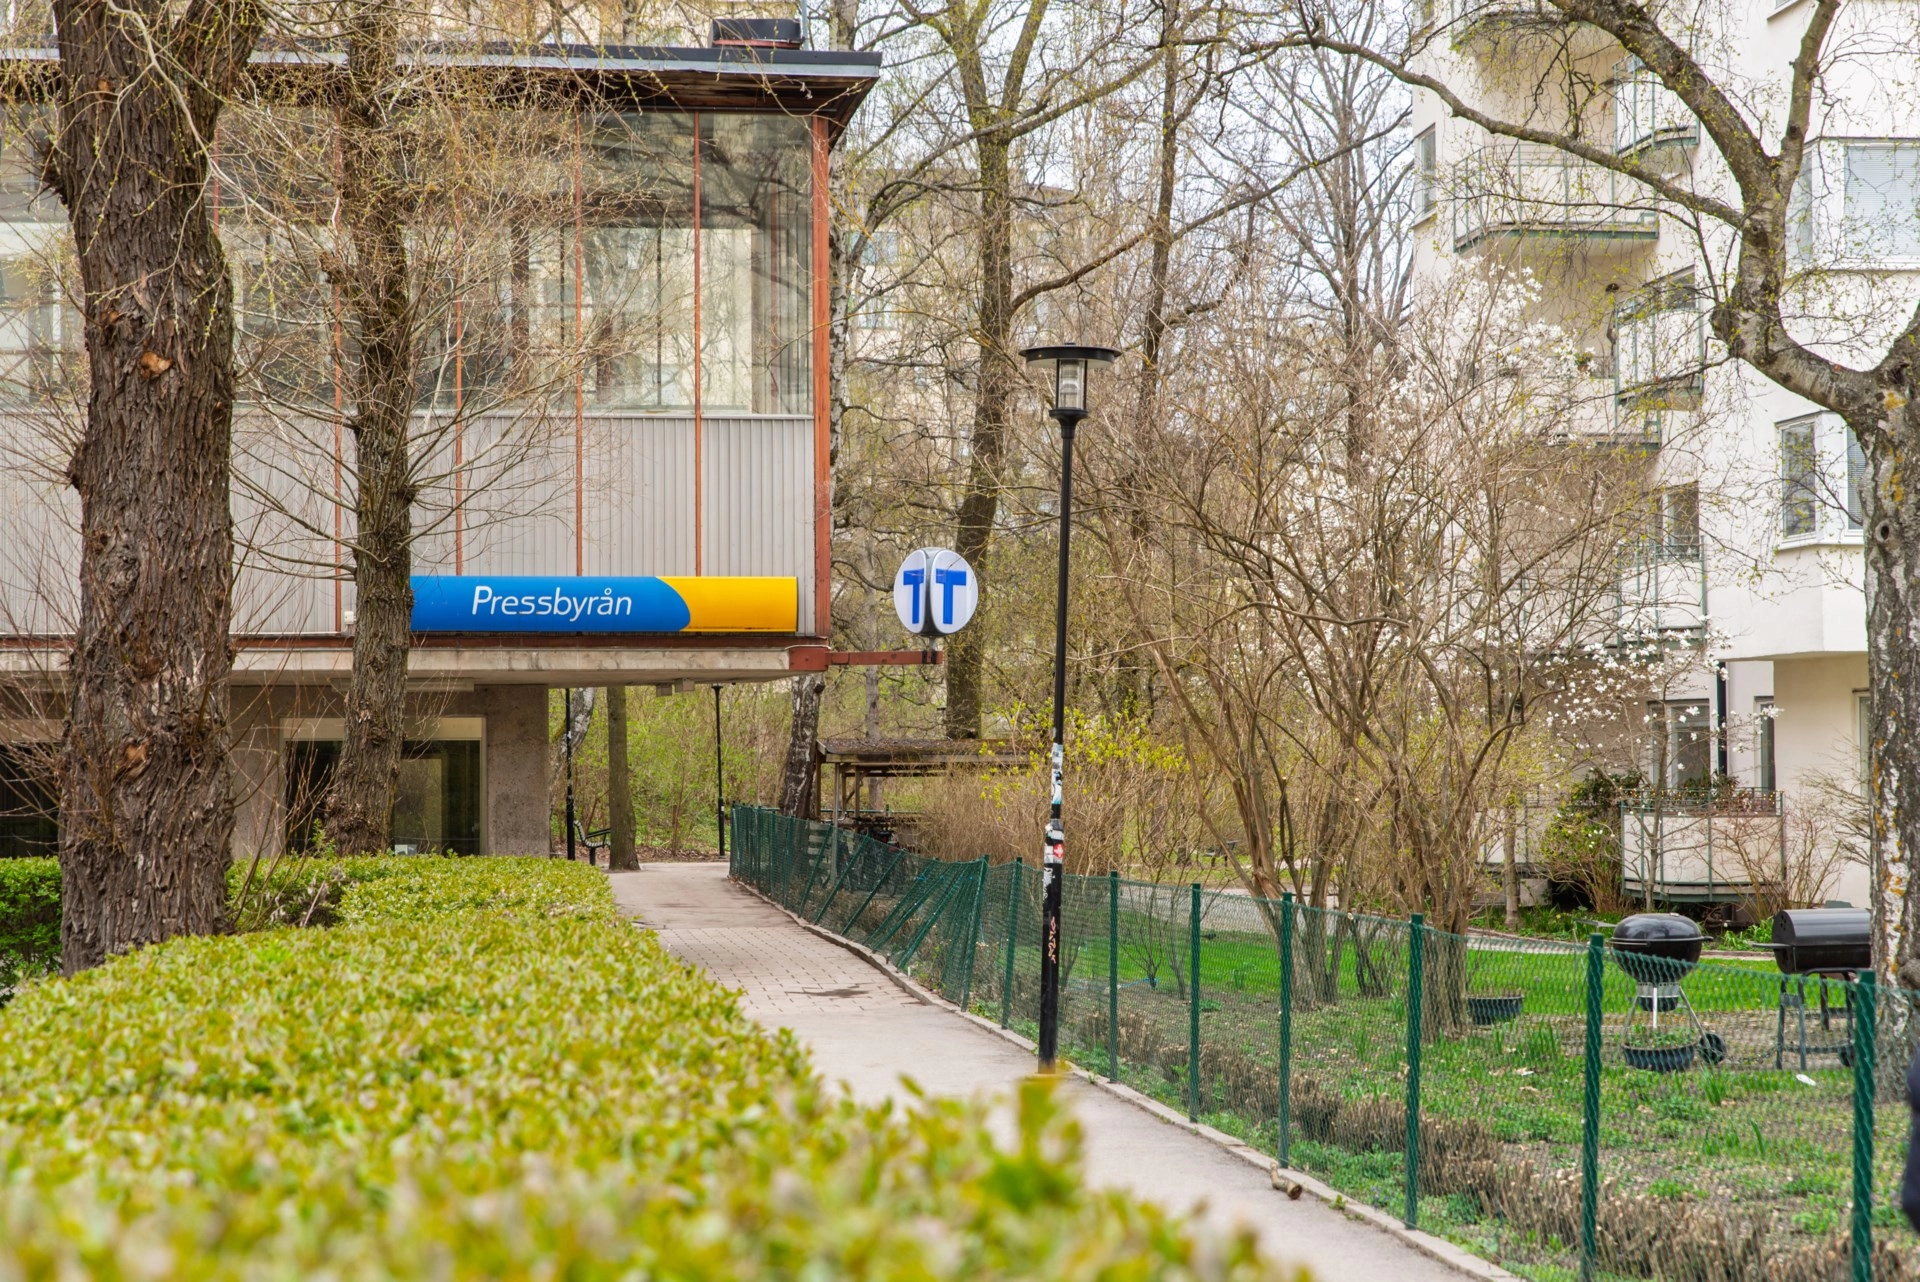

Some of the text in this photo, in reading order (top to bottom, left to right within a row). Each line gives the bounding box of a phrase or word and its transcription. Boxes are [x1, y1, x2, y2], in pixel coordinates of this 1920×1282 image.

[472, 585, 632, 622] Pressbyrån
[903, 568, 924, 624] T
[936, 568, 967, 625] T
